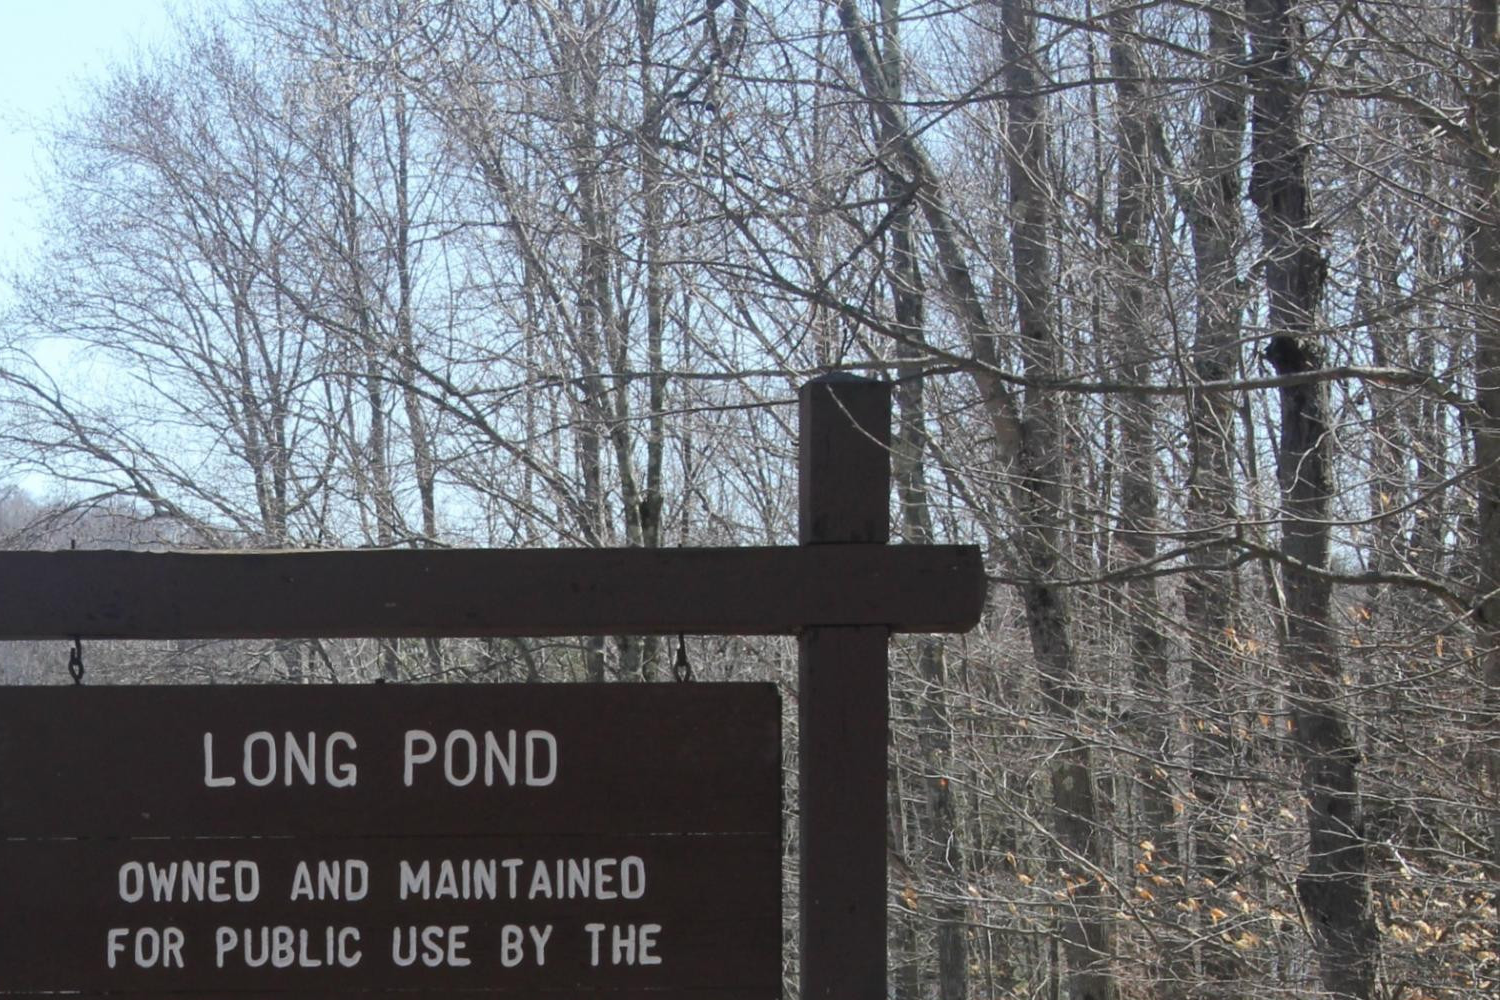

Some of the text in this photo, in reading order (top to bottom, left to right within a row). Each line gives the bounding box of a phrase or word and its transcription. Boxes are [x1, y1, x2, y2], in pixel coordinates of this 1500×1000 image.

[203, 729, 558, 788] LONG POND
[118, 856, 646, 903] OWNED AND MAINTAINED
[107, 924, 662, 968] FOR PUBLIC USE BY THE
